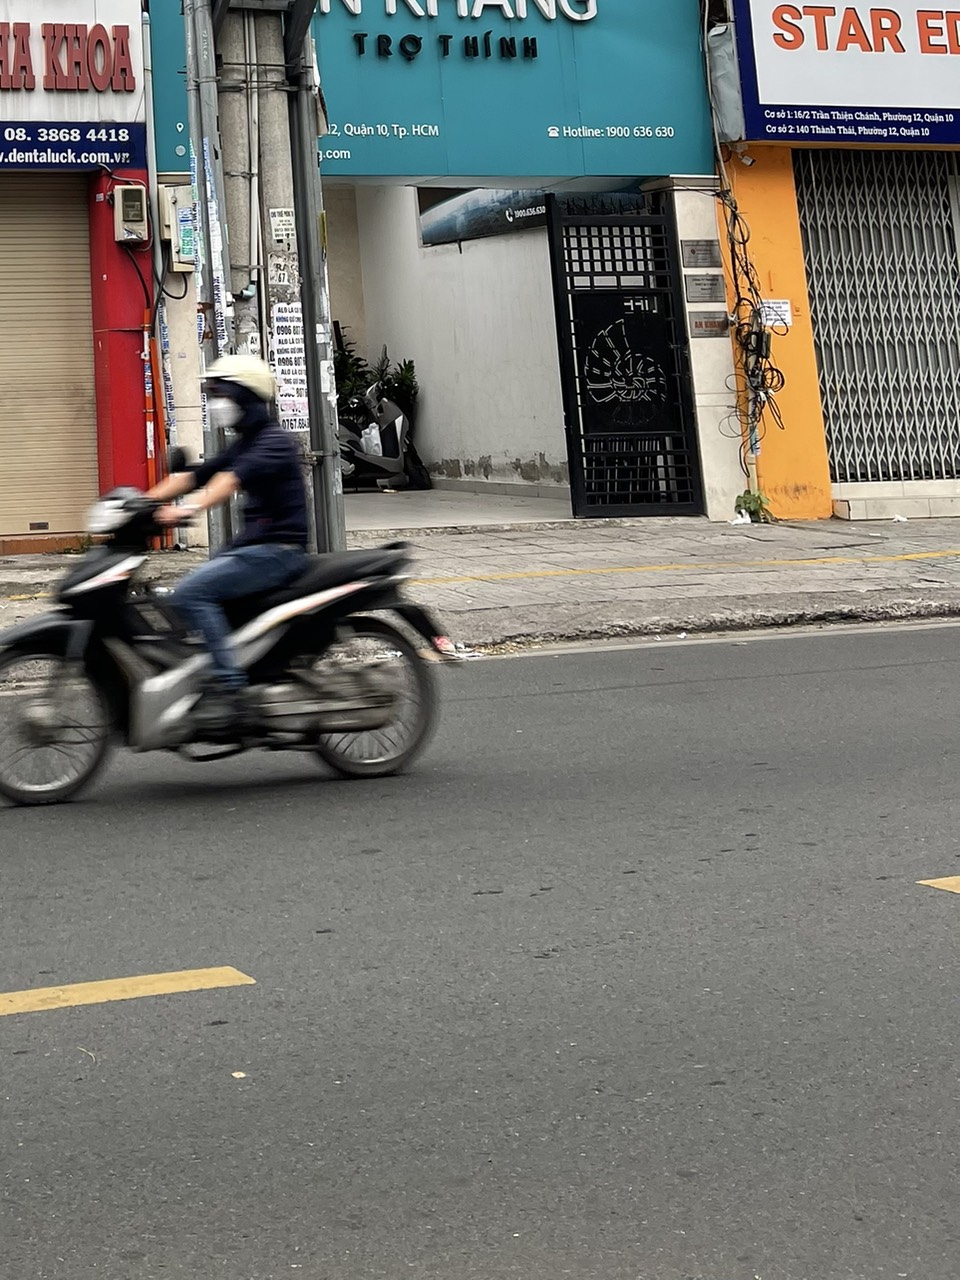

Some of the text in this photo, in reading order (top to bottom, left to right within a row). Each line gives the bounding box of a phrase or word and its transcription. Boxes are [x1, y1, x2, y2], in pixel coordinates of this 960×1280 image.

[772, 4, 906, 53] STAR
[354, 30, 537, 61] TRỢ THÍNH
[41, 23, 136, 93] KHOA
[794, 111, 810, 119] 16/2
[945, 114, 954, 122] 10
[4, 128, 32, 141] 08.
[37, 128, 81, 142] 3868
[86, 129, 130, 142] 4418
[344, 123, 374, 138] Quận
[376, 124, 390, 137] 10,
[391, 124, 410, 139] Tp.
[412, 125, 439, 136] HCM
[563, 126, 674, 137] Hotline: 1900 636 630
[796, 125, 809, 133] 140
[921, 128, 930, 136] 10
